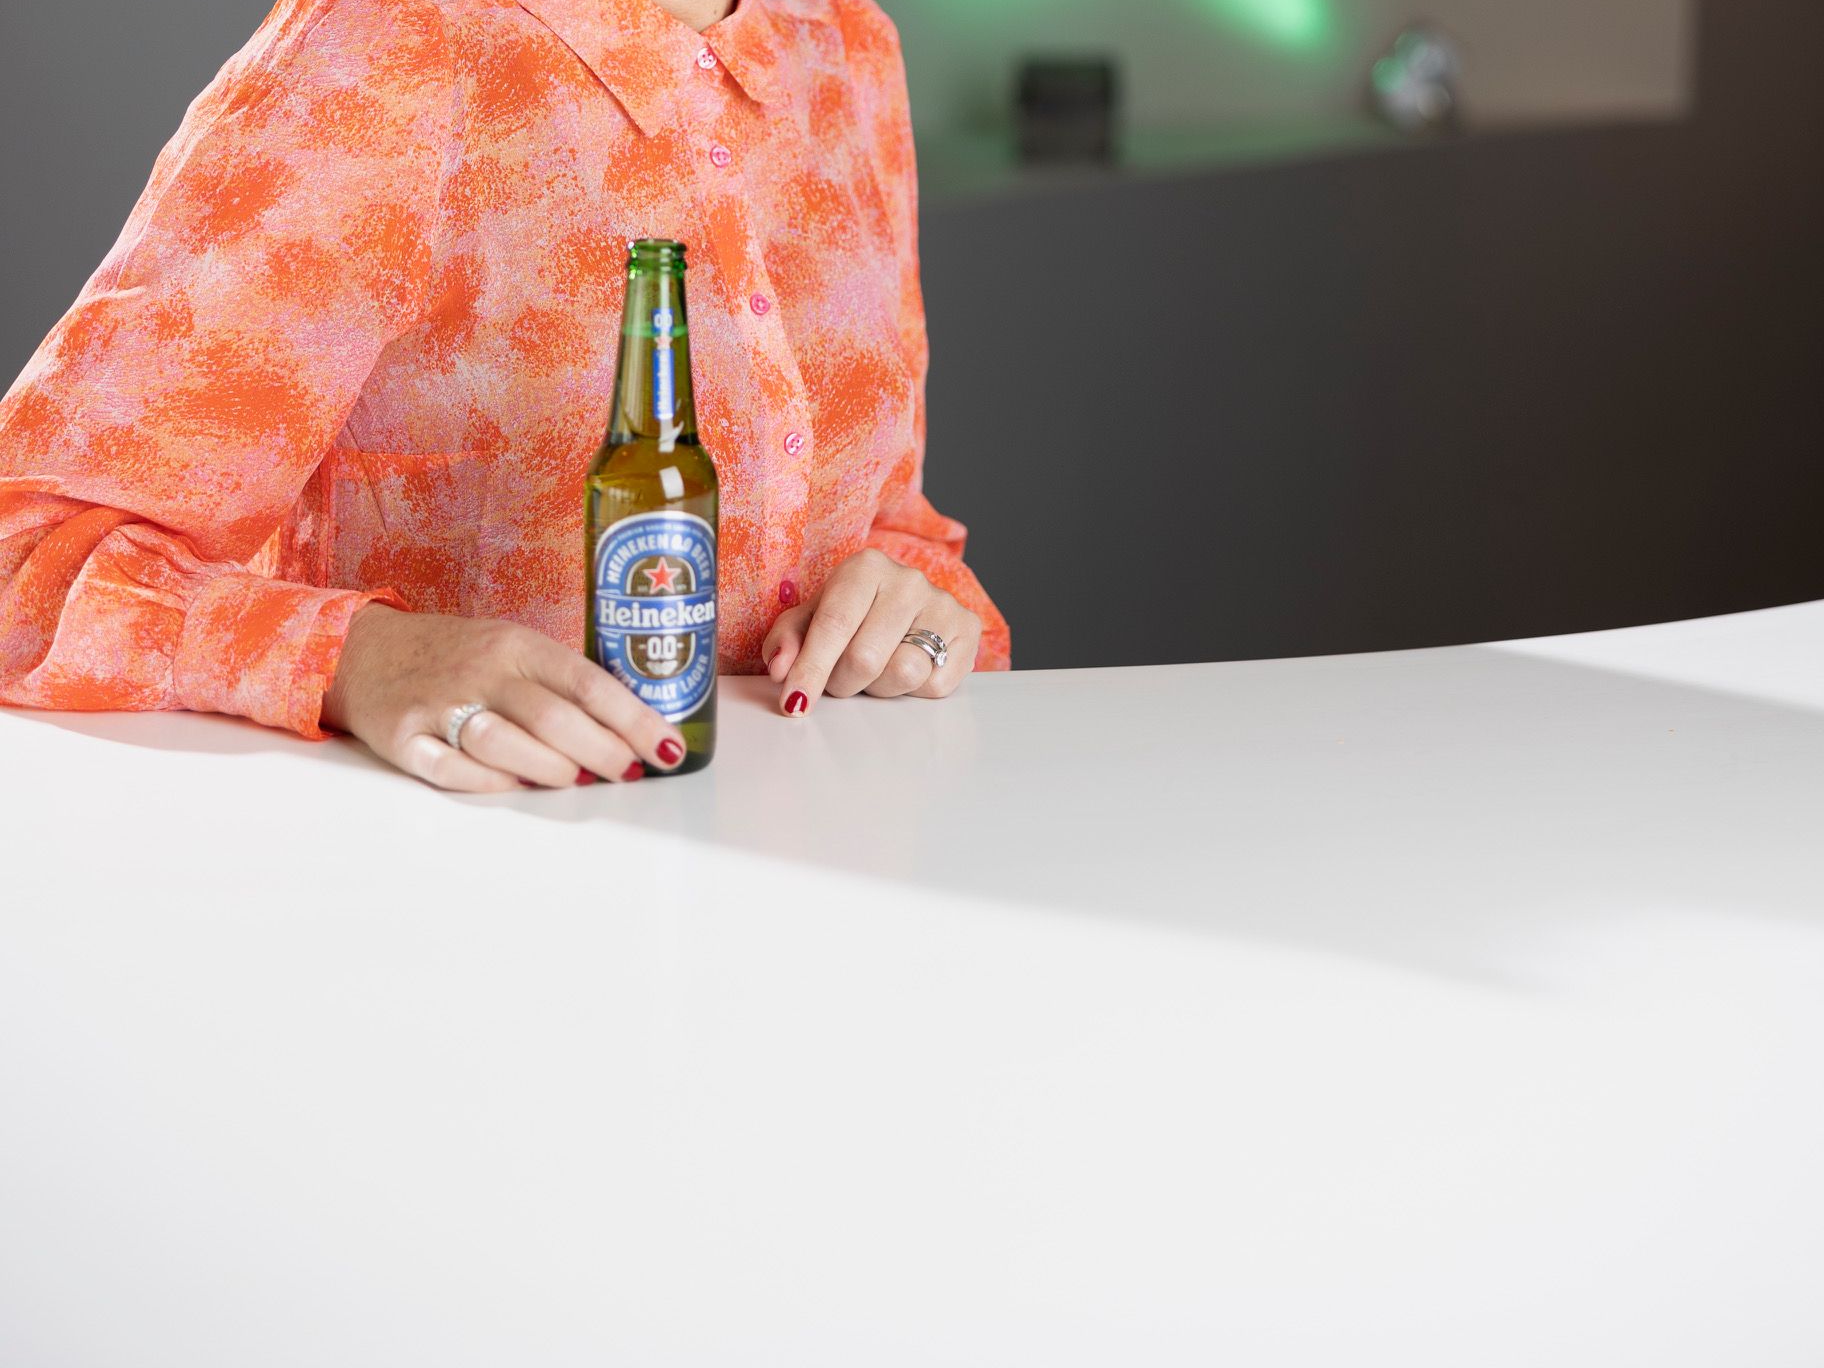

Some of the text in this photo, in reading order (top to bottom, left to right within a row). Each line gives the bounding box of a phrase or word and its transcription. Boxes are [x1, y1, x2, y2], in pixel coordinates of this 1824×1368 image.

[606, 533, 669, 584] HEINEKEN
[690, 543, 711, 581] BEER
[600, 598, 716, 628] Heineken
[639, 683, 678, 700] MALT
[679, 654, 709, 693] LAGER
